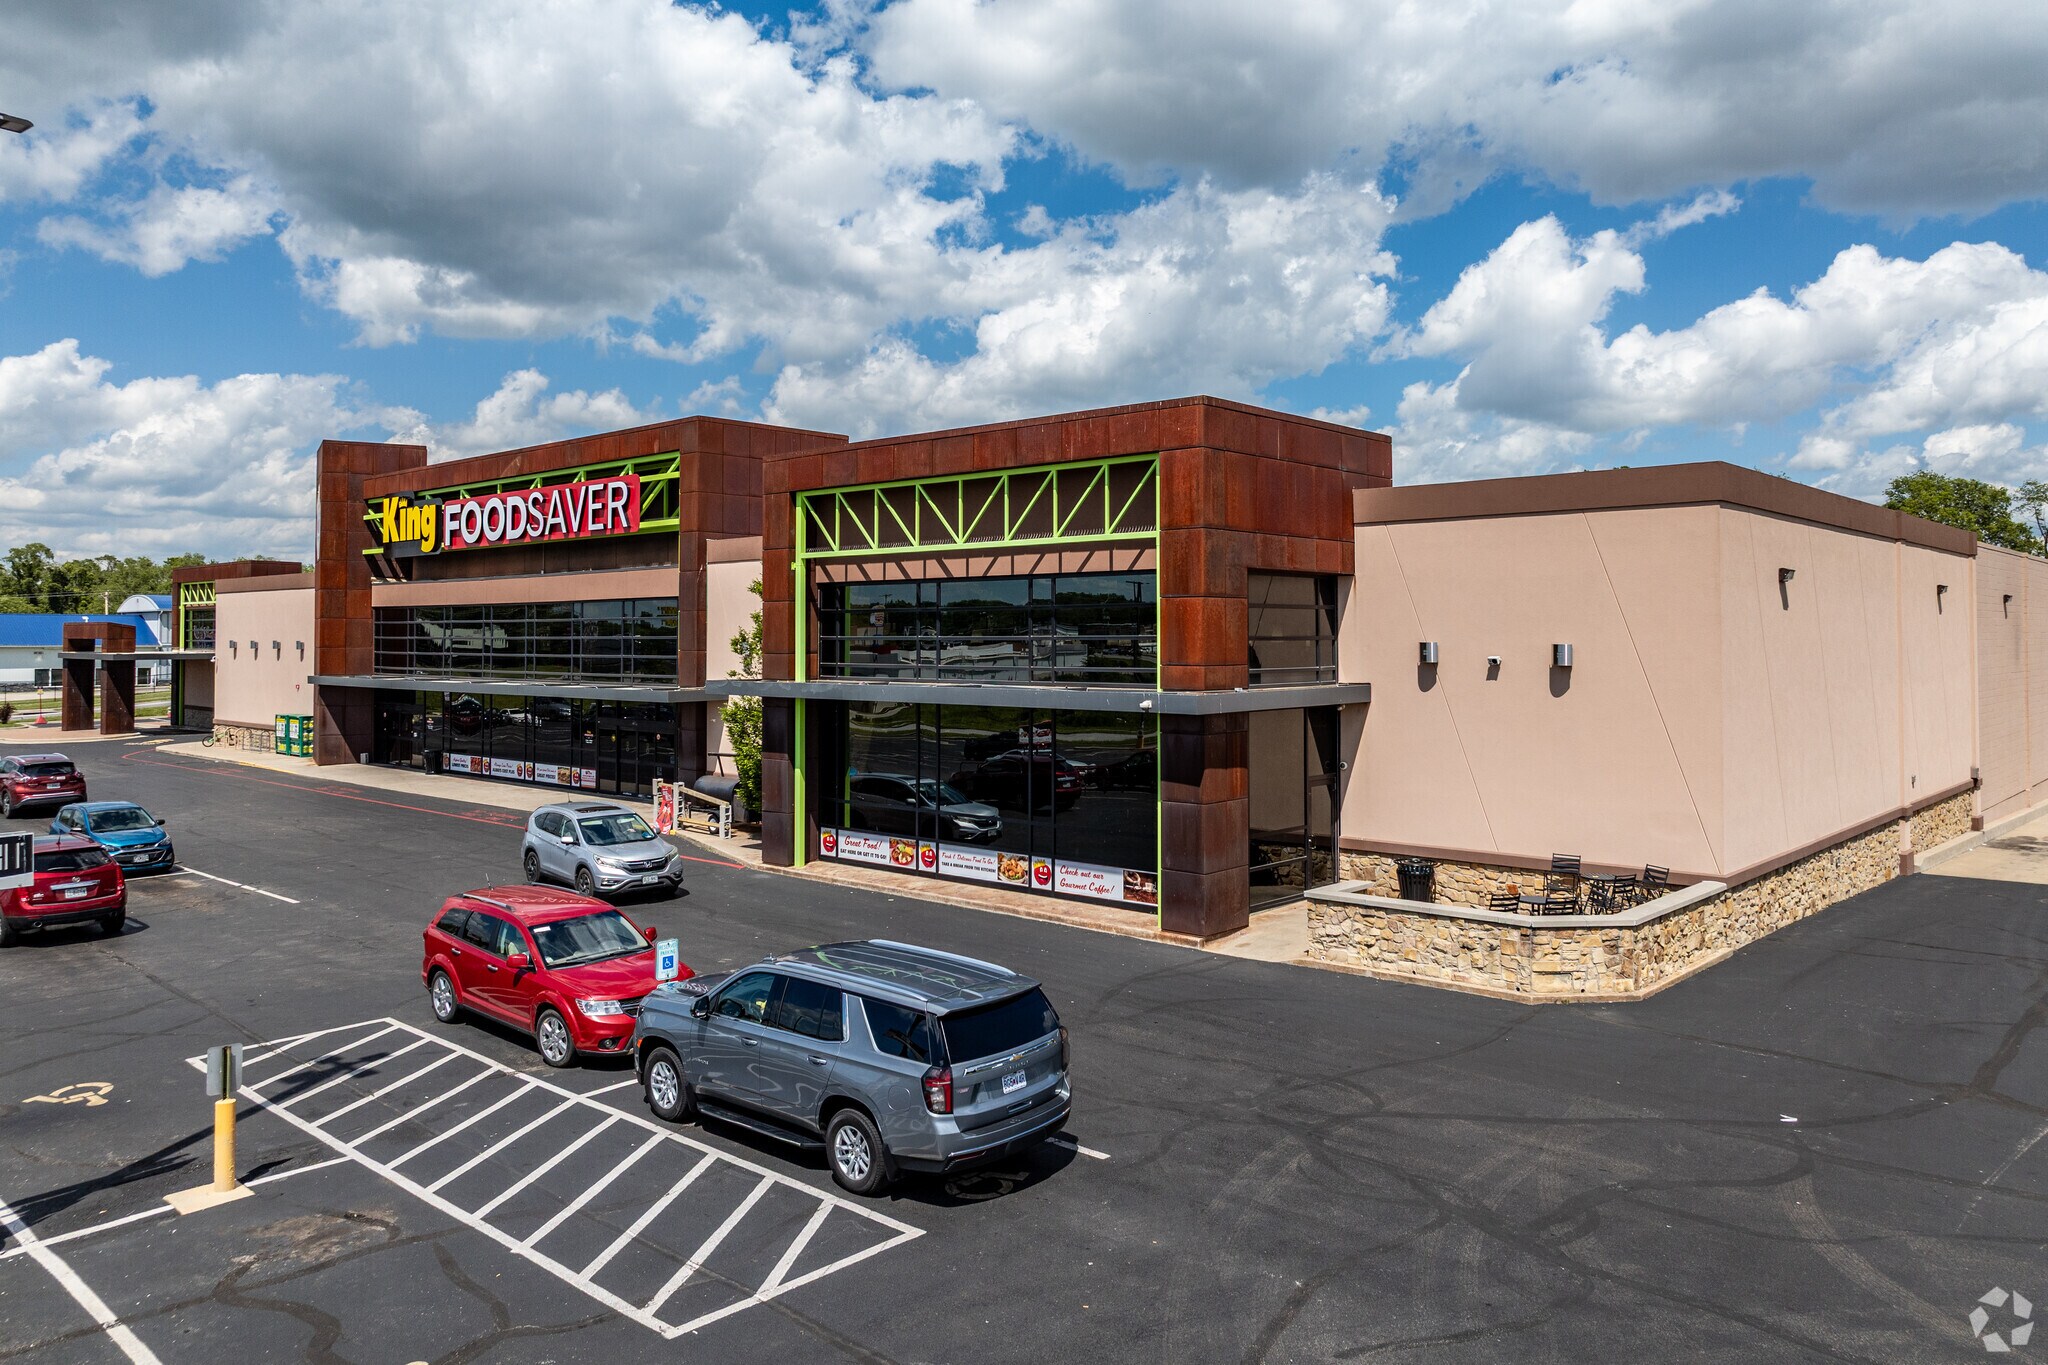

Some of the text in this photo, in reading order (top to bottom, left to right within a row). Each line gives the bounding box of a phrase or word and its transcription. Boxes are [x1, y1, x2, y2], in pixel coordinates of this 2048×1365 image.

[382, 481, 628, 553] King FOODSAVER
[844, 835, 882, 850] Great Food!
[956, 854, 972, 862] Delicious
[1060, 864, 1079, 876] Check
[1060, 878, 1115, 894] Gourmet Coffee!
